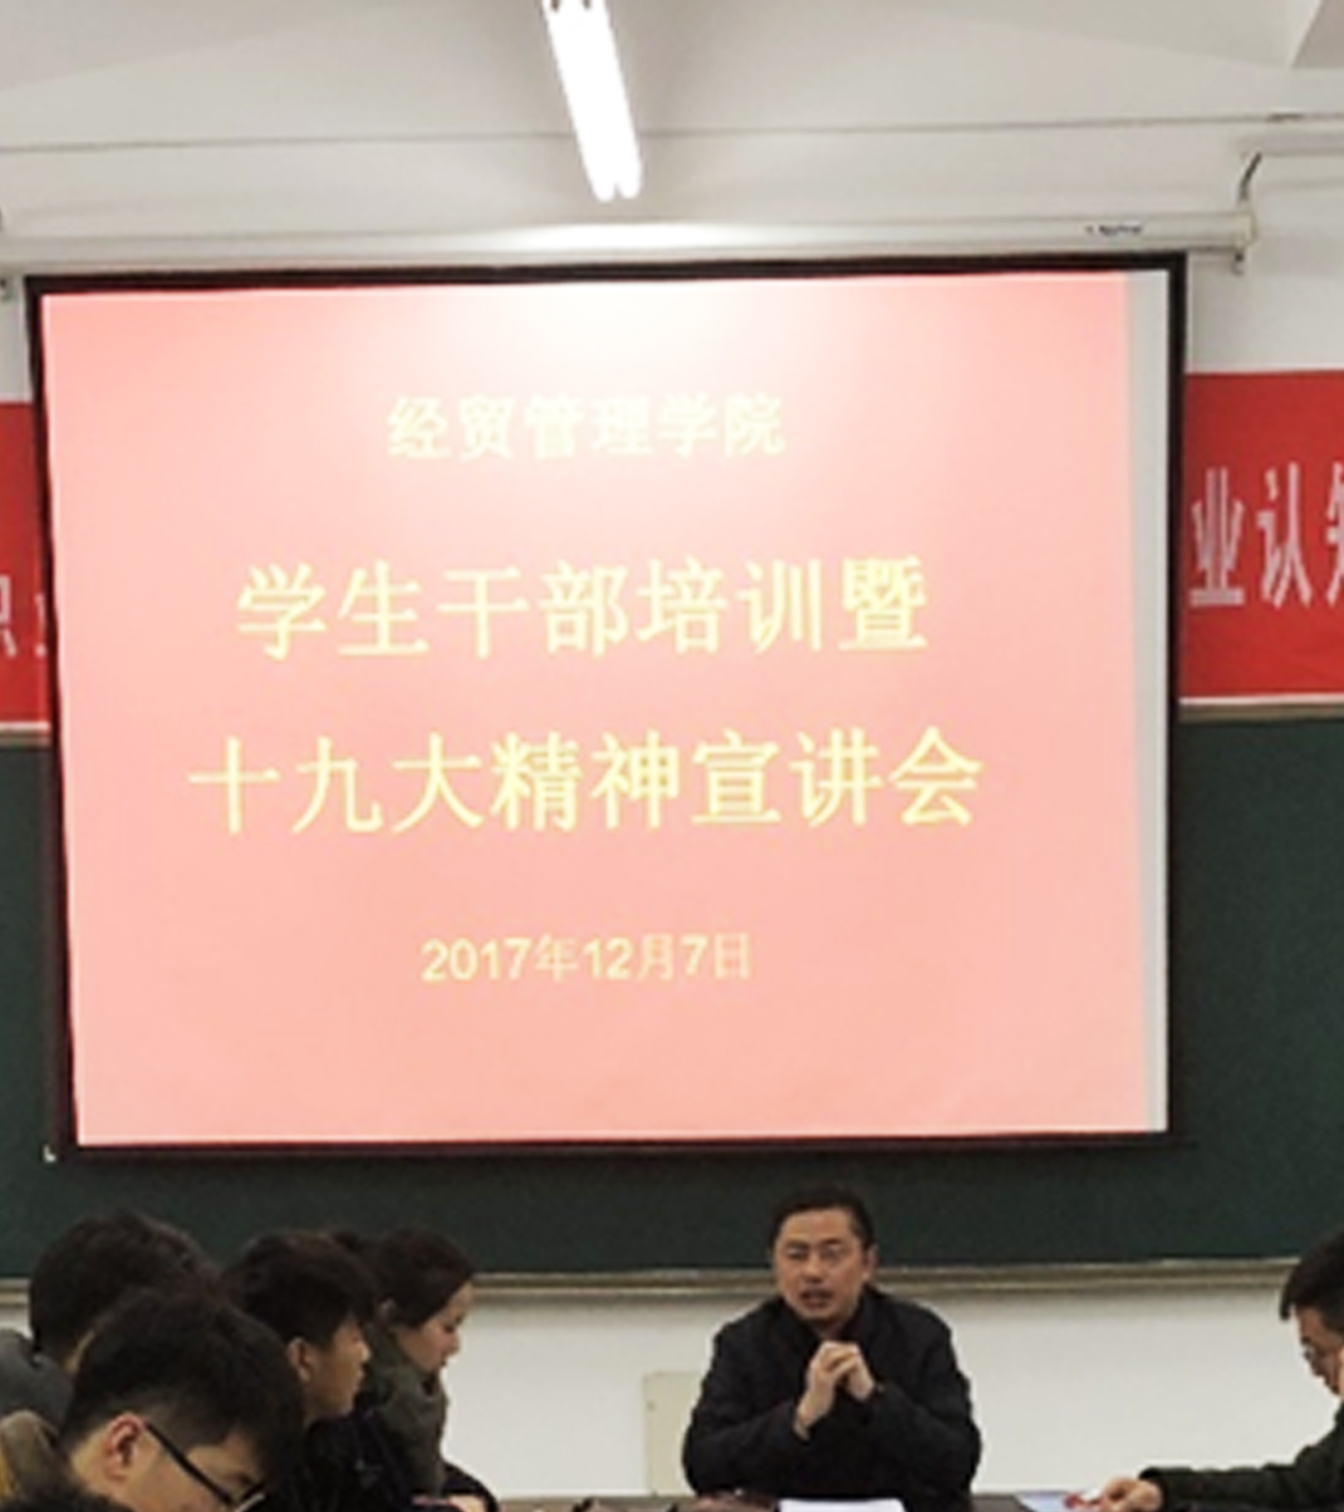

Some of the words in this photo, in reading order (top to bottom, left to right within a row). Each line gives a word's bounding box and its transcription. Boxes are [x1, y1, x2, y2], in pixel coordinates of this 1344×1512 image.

[386, 394, 786, 460] 经贸管理学院
[235, 554, 931, 660] 学生干部培训暨
[188, 726, 984, 835] 十九大精神宣讲会
[421, 934, 752, 982] 2017年12月7日
